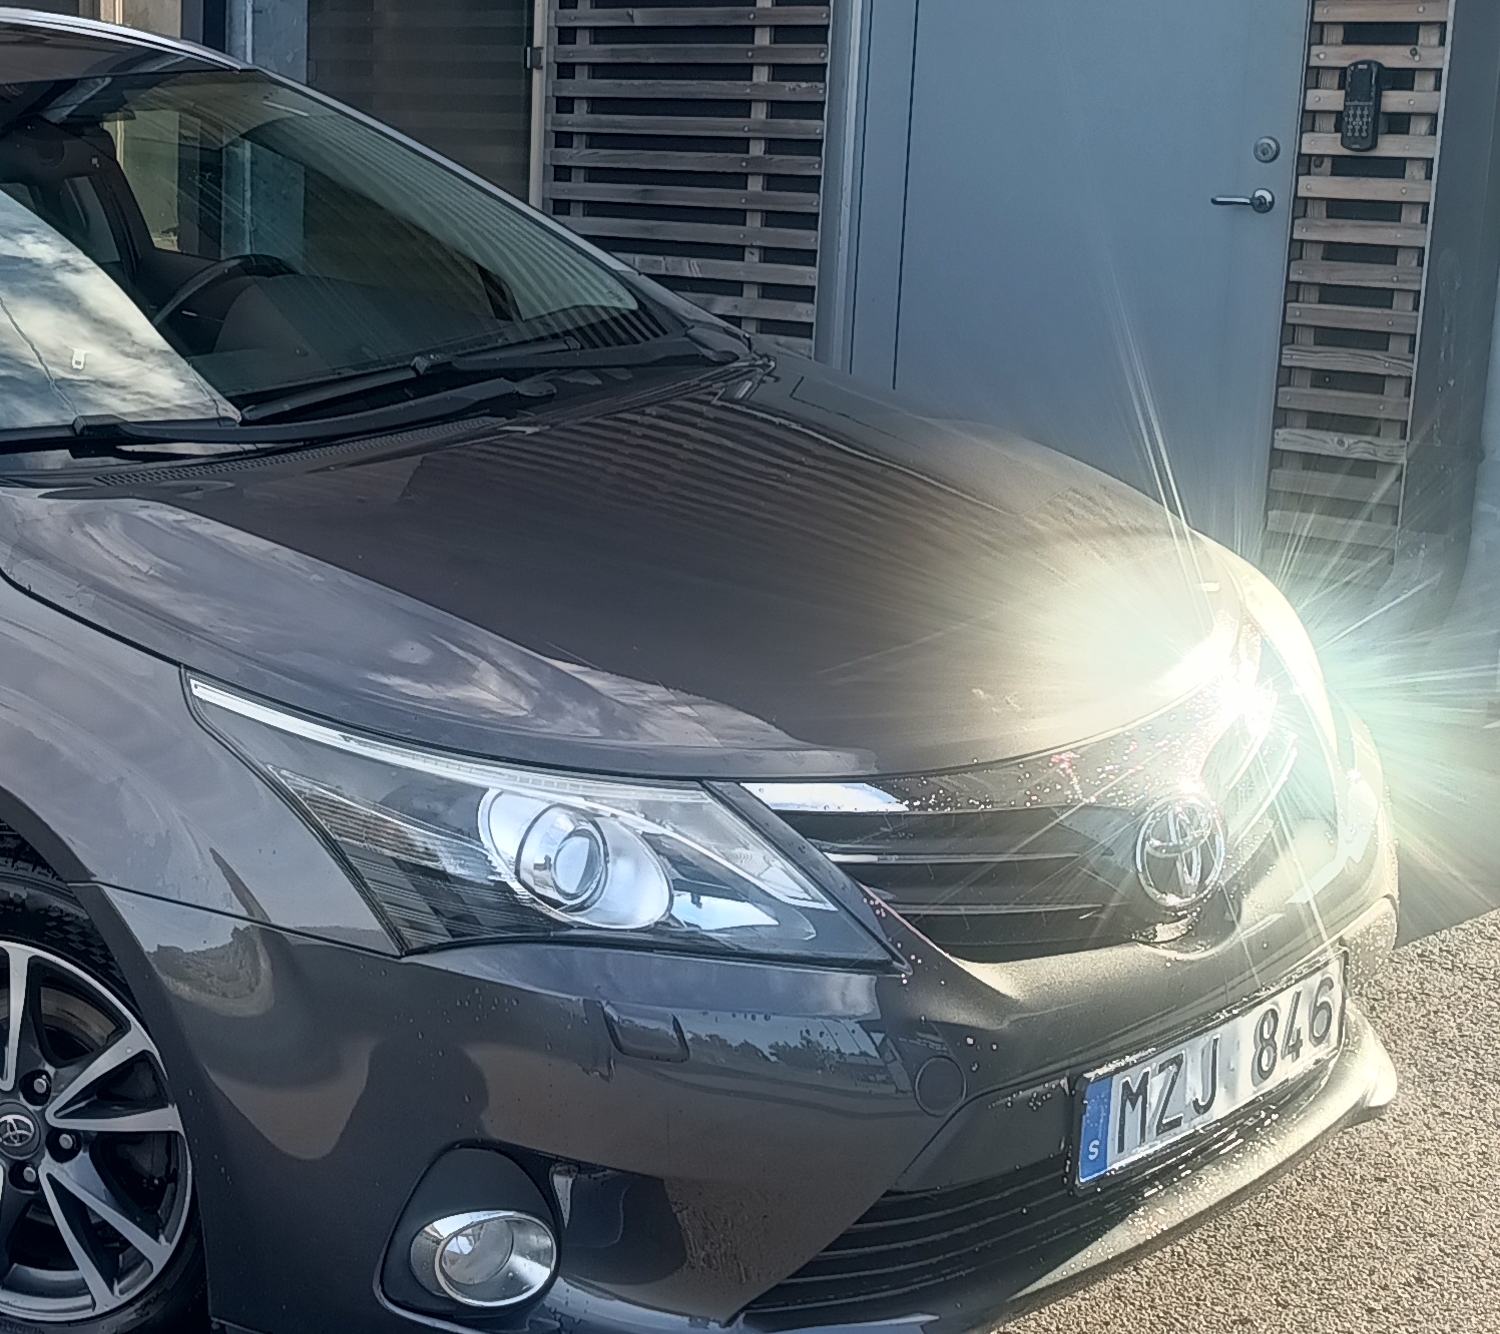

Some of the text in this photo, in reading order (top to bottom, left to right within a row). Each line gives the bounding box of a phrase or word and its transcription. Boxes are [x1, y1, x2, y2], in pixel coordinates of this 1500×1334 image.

[1116, 975, 1335, 1155] MZJ 846
[1088, 1139, 1100, 1161] S
